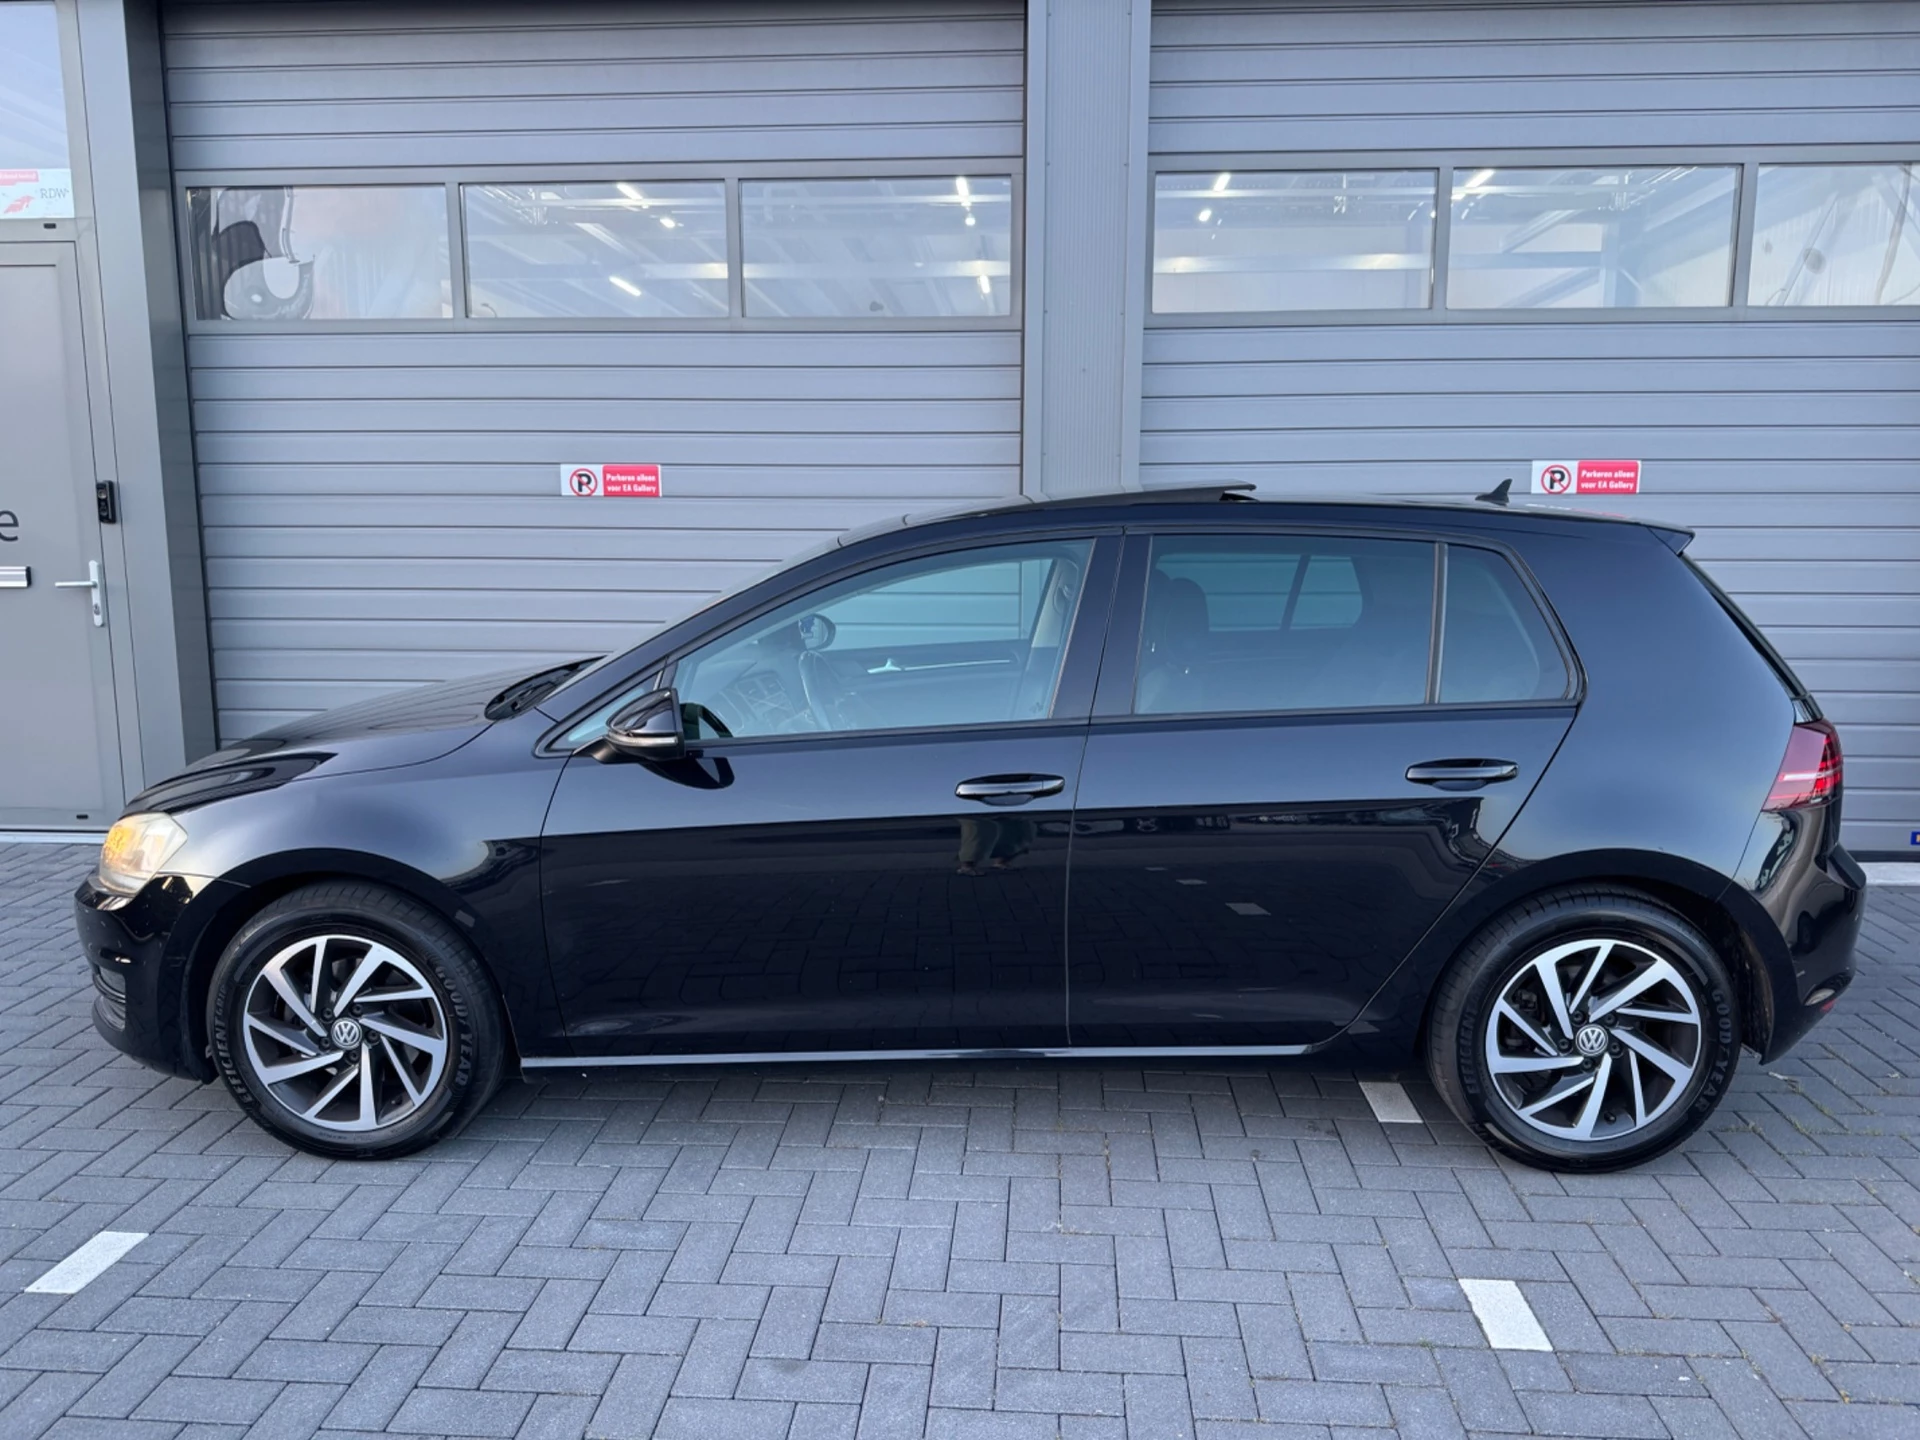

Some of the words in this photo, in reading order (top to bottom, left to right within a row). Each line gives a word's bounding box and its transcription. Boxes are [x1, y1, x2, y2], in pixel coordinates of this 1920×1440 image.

[606, 473, 635, 482] Parkeren
[637, 473, 655, 482] alleen
[1581, 470, 1612, 478] Parkeren
[1614, 470, 1635, 478] alleen
[577, 473, 592, 493] P
[1549, 470, 1565, 490] P
[623, 484, 631, 492] EA
[633, 484, 656, 494] Gallery
[1598, 481, 1607, 489] EA
[1609, 481, 1634, 490] Gallery
[0, 510, 19, 542] e
